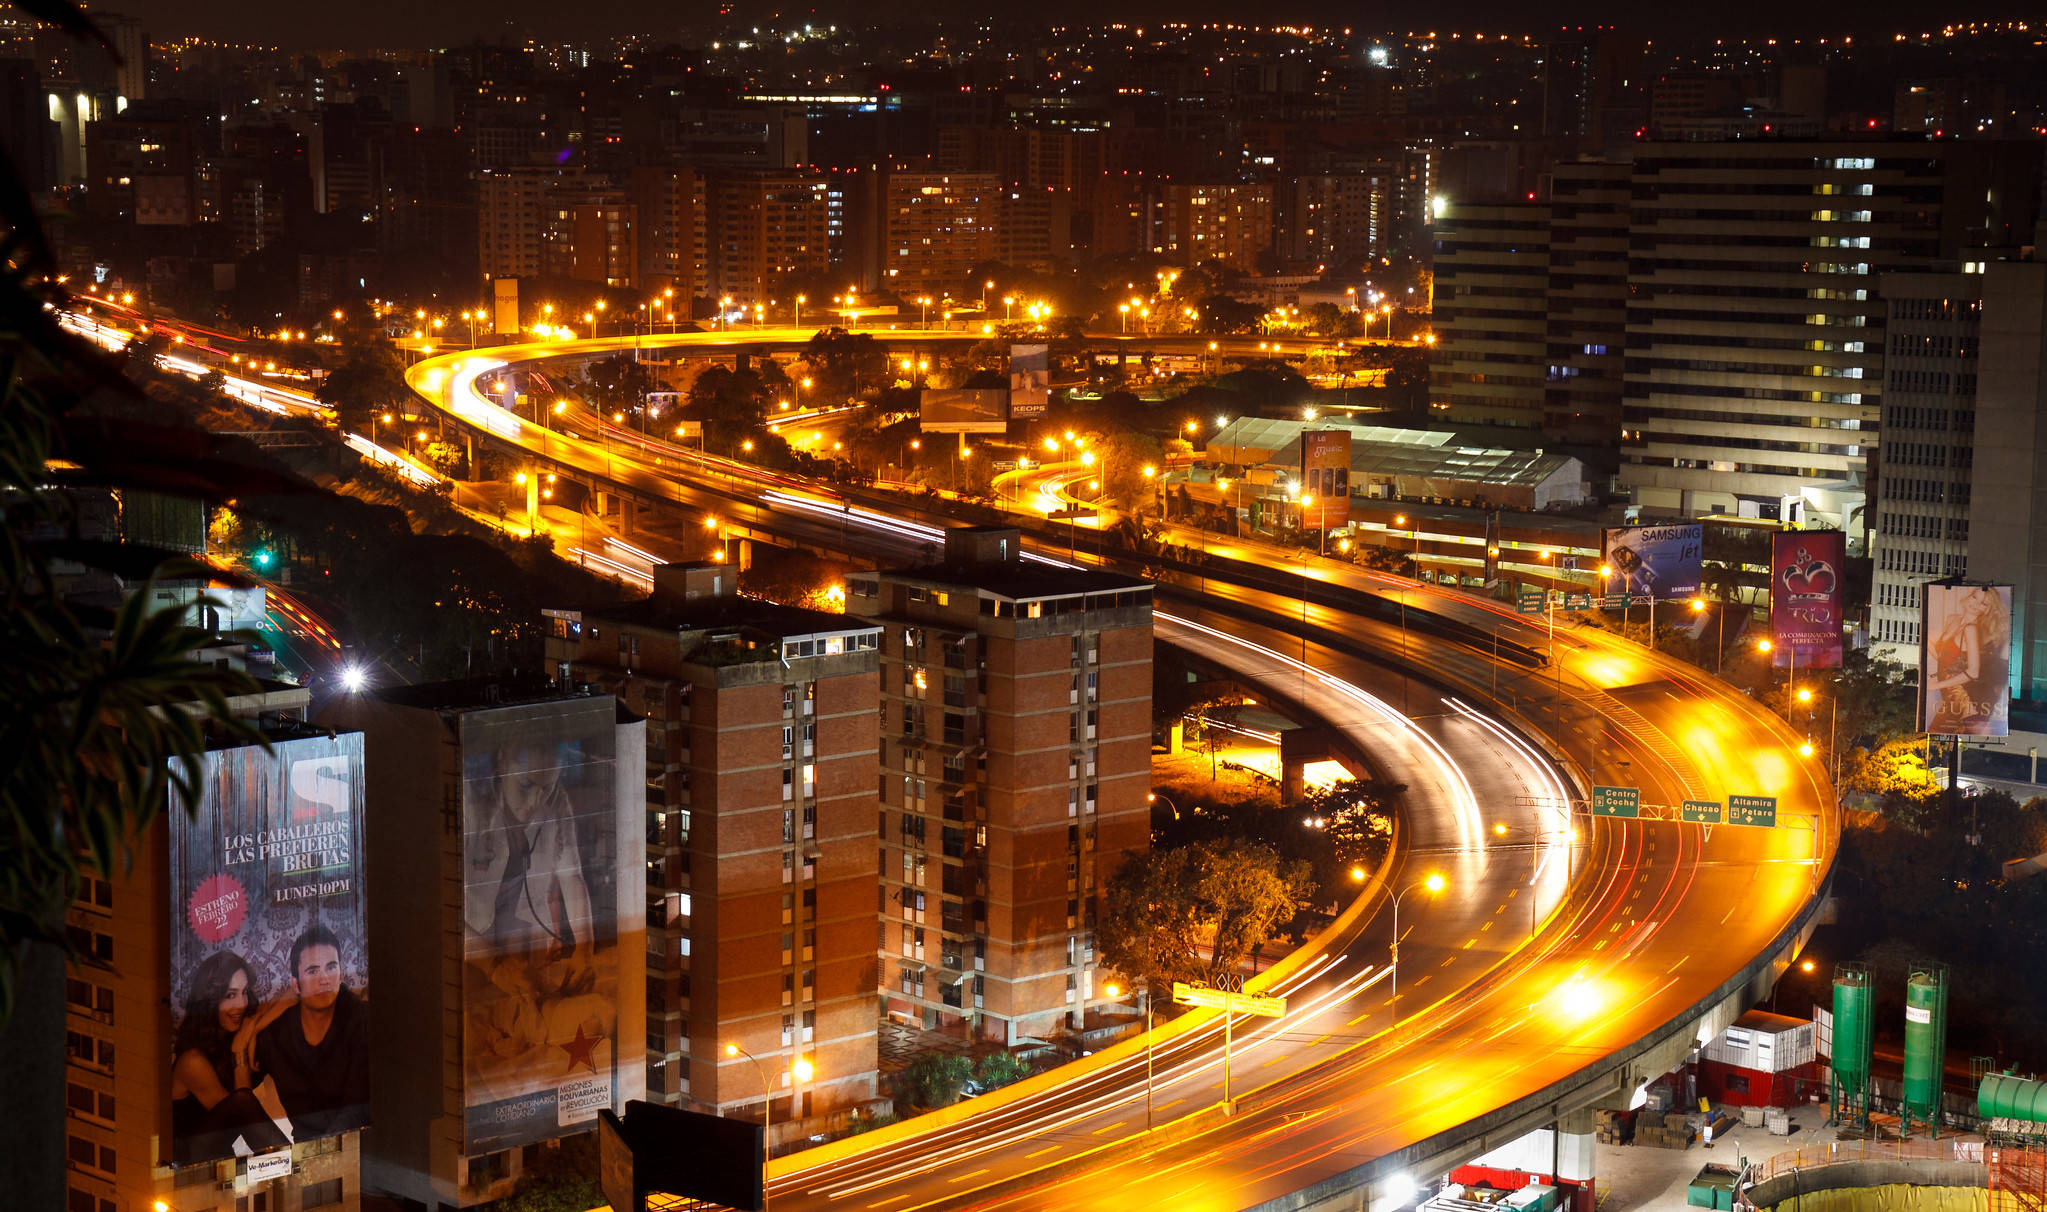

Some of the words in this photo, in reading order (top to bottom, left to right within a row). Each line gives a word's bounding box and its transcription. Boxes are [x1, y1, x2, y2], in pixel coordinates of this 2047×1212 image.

[1641, 527, 1701, 542] SAMSUNG
[1671, 585, 1696, 593] SAMSUNG
[1933, 700, 2003, 717] GUESS
[1605, 789, 1637, 799] Centro
[1606, 797, 1635, 807] Coche
[1732, 797, 1773, 807] Altamira
[1684, 803, 1720, 813] Chacao
[1741, 807, 1774, 817] Petare
[225, 833, 253, 850] LOS
[257, 818, 349, 846] CABALLEROS
[225, 847, 255, 865] LAS
[259, 833, 349, 861] PREFIEREN
[283, 847, 350, 872] BRUTAS
[276, 886, 318, 902] LUNES
[318, 879, 351, 895] 10PM
[194, 890, 240, 918] ESTRENO
[198, 901, 239, 925] FEBRERO
[213, 914, 229, 930] 22
[559, 1079, 593, 1094] MISIONES
[559, 1086, 608, 1102] BOLIVARIANAS
[495, 1094, 557, 1115] EXTRAORDINARIO
[495, 1108, 536, 1123] COTIDIANO
